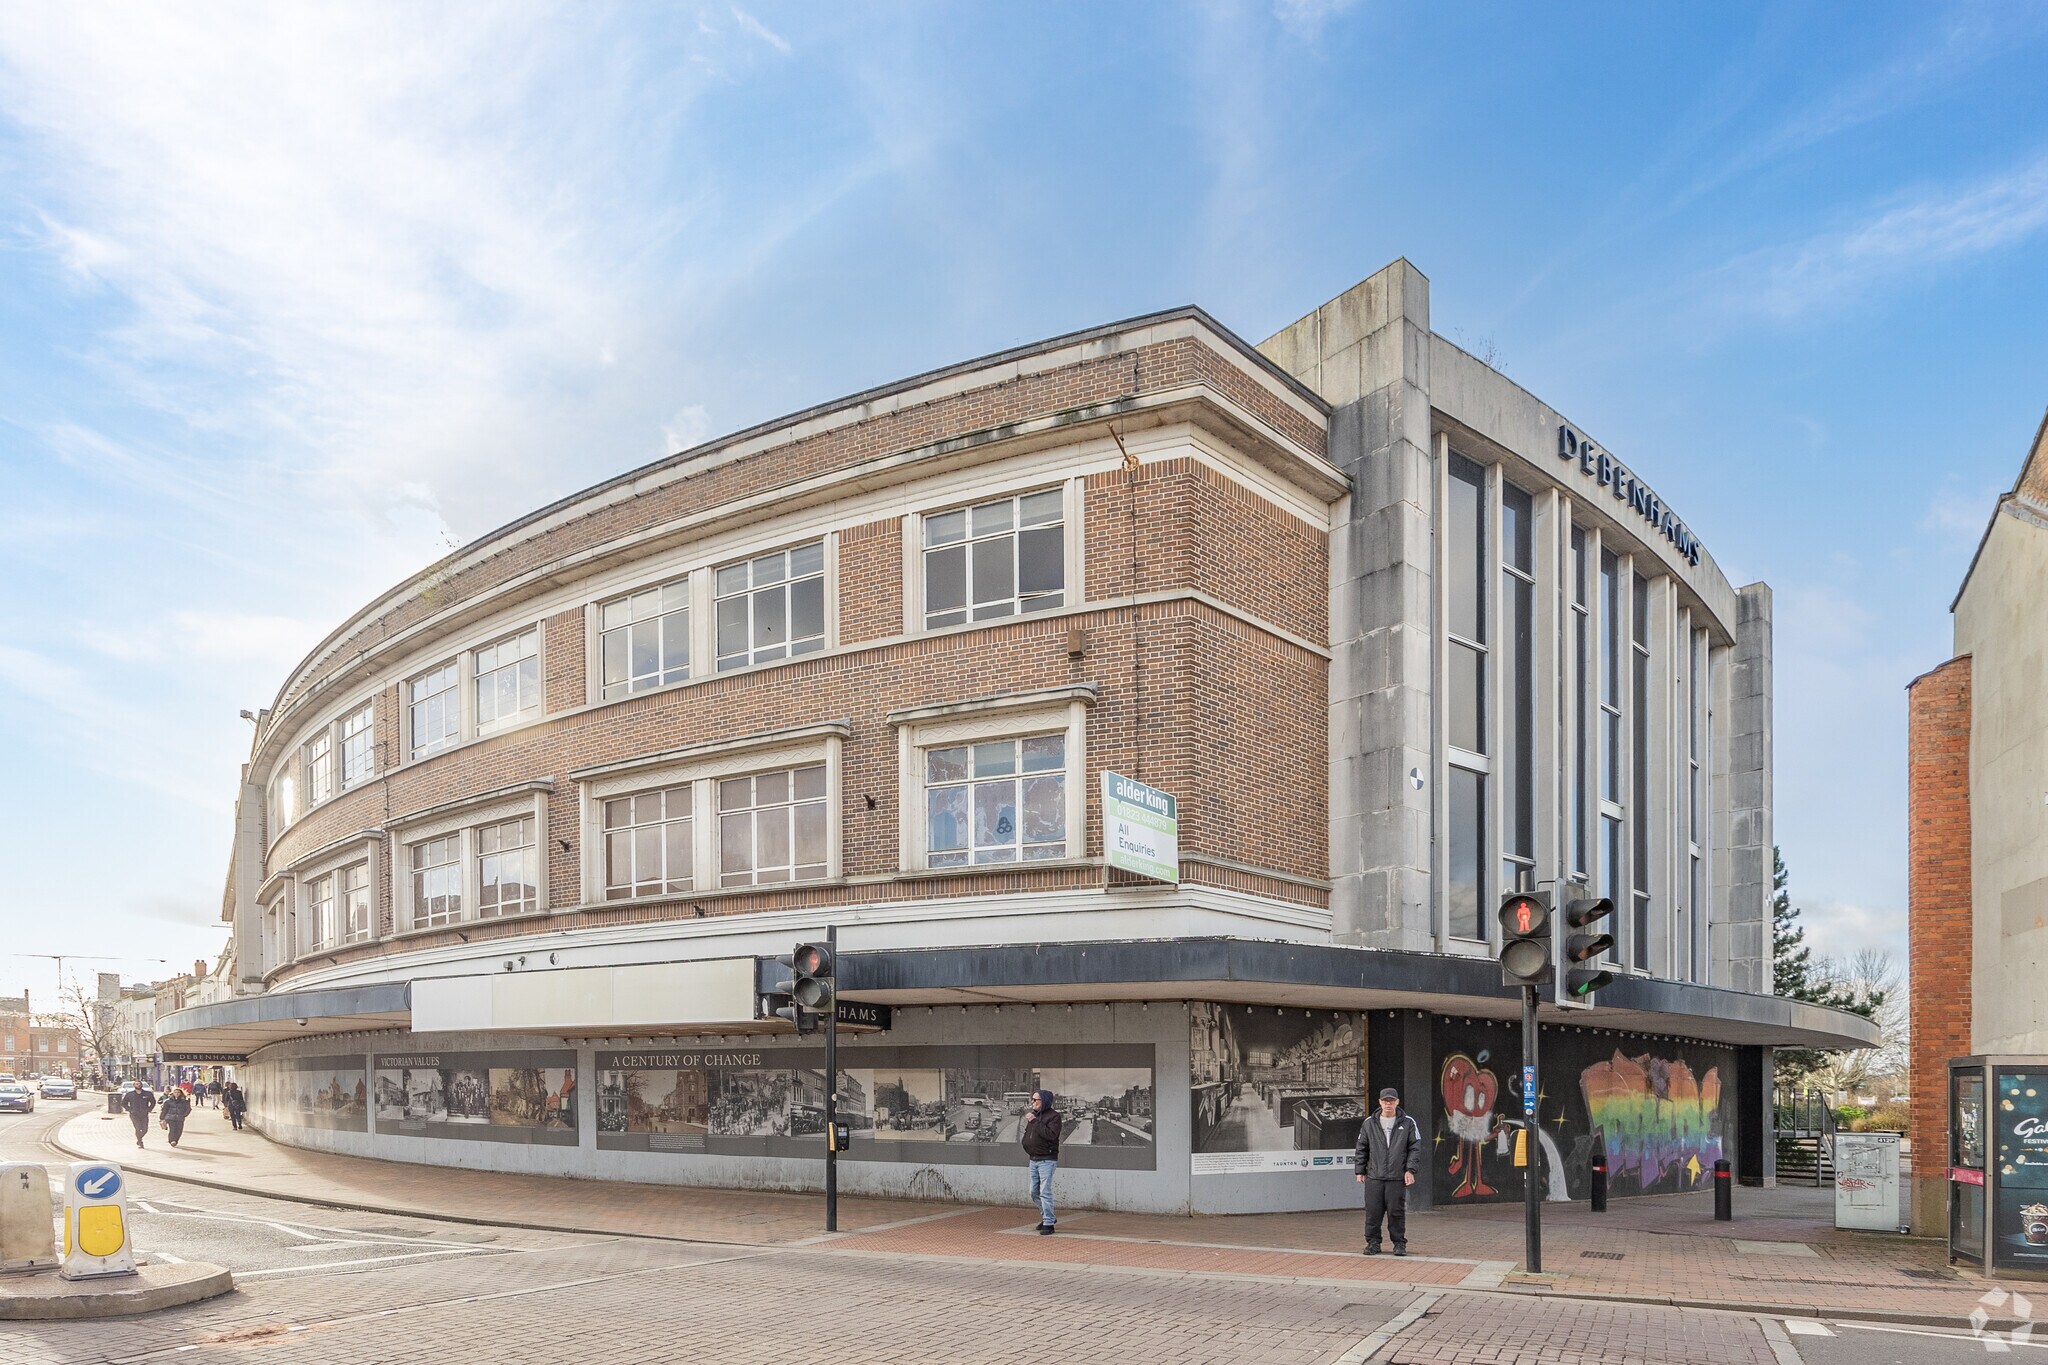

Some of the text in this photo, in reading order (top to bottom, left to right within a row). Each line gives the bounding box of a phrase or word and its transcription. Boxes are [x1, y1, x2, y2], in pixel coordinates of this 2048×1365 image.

[1558, 424, 1700, 566] DEBENHAMS
[1116, 780, 1168, 816] alder king
[1118, 822, 1129, 836] All
[1119, 837, 1156, 858] Enquiries
[1119, 854, 1171, 878] alderking.com
[380, 1056, 440, 1067] VICTORIAN VALUES
[612, 1053, 761, 1067] A CENTURY OF CHANGE
